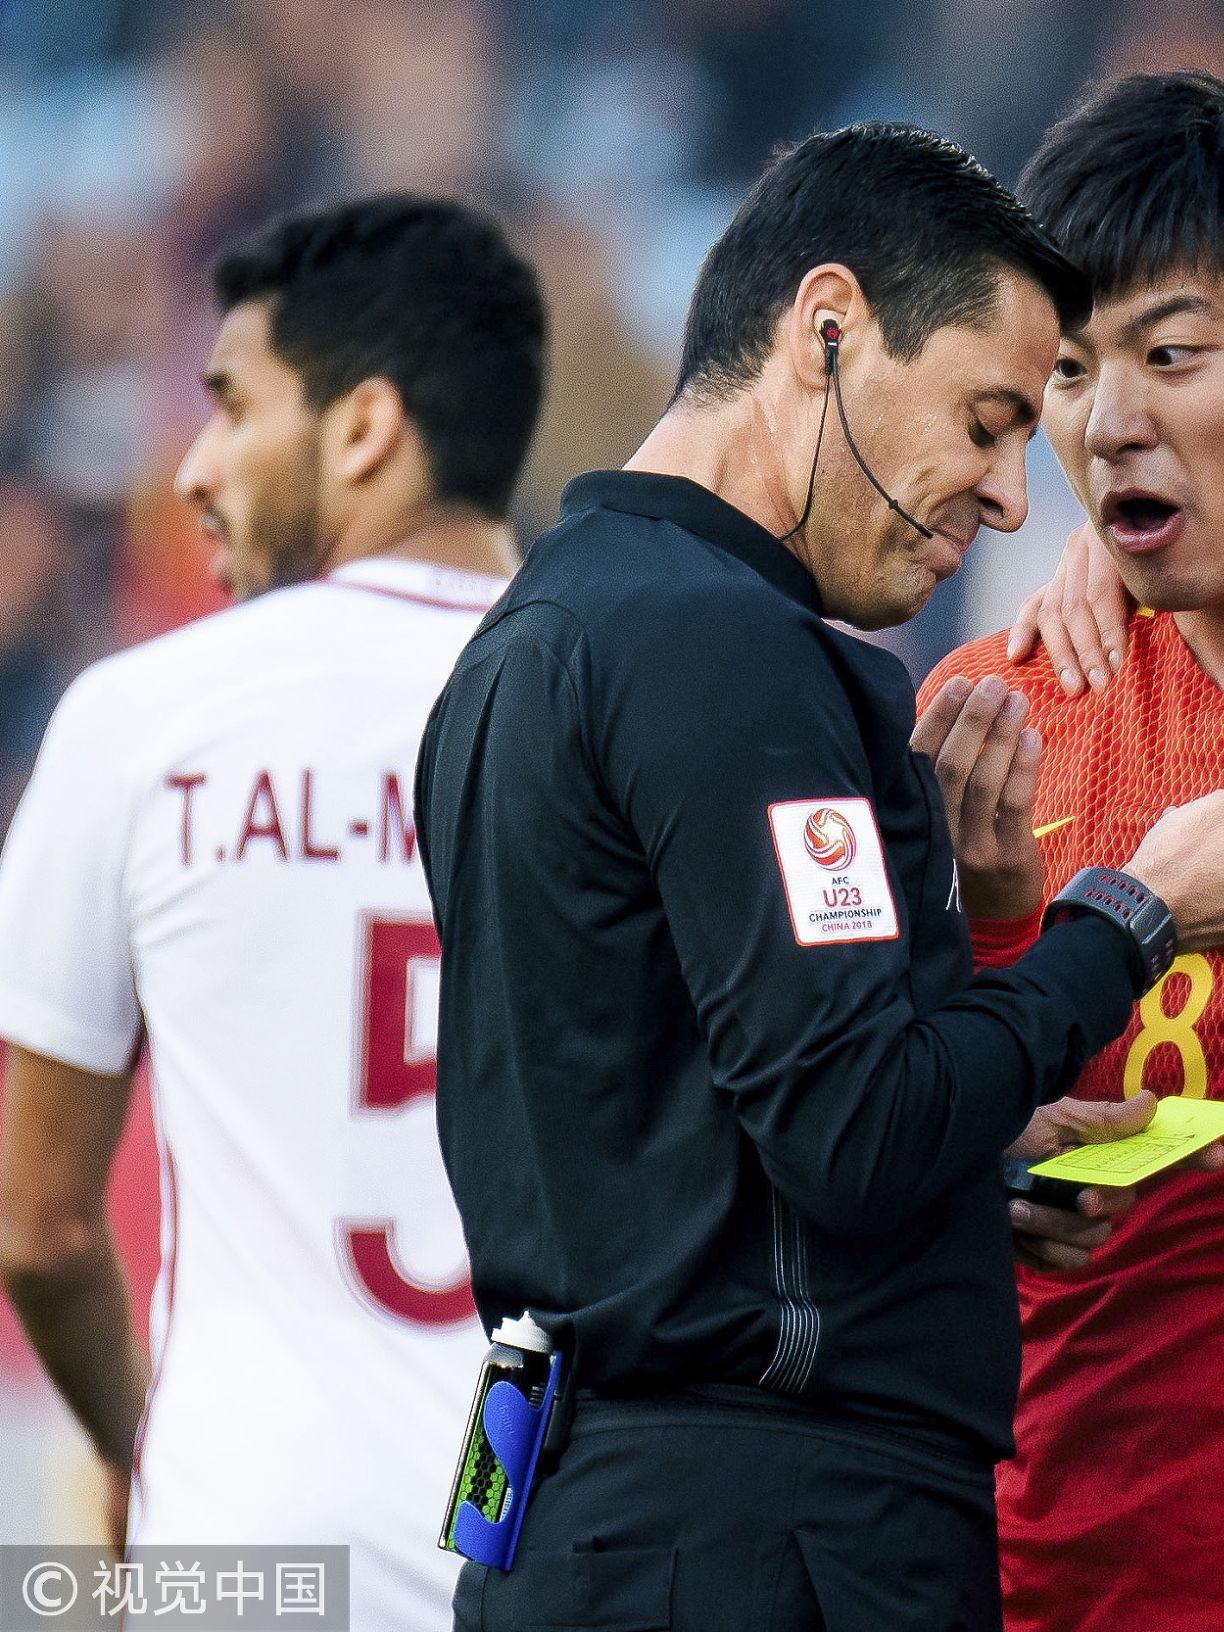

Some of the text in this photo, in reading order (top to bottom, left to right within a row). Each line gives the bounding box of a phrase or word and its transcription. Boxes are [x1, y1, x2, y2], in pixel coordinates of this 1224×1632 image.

[832, 876, 849, 885] AFC
[823, 887, 862, 908] U23
[809, 908, 882, 922] CHAMPIONSHIP
[822, 920, 872, 932] CHINA 2018
[1123, 953, 1214, 1100] 8
